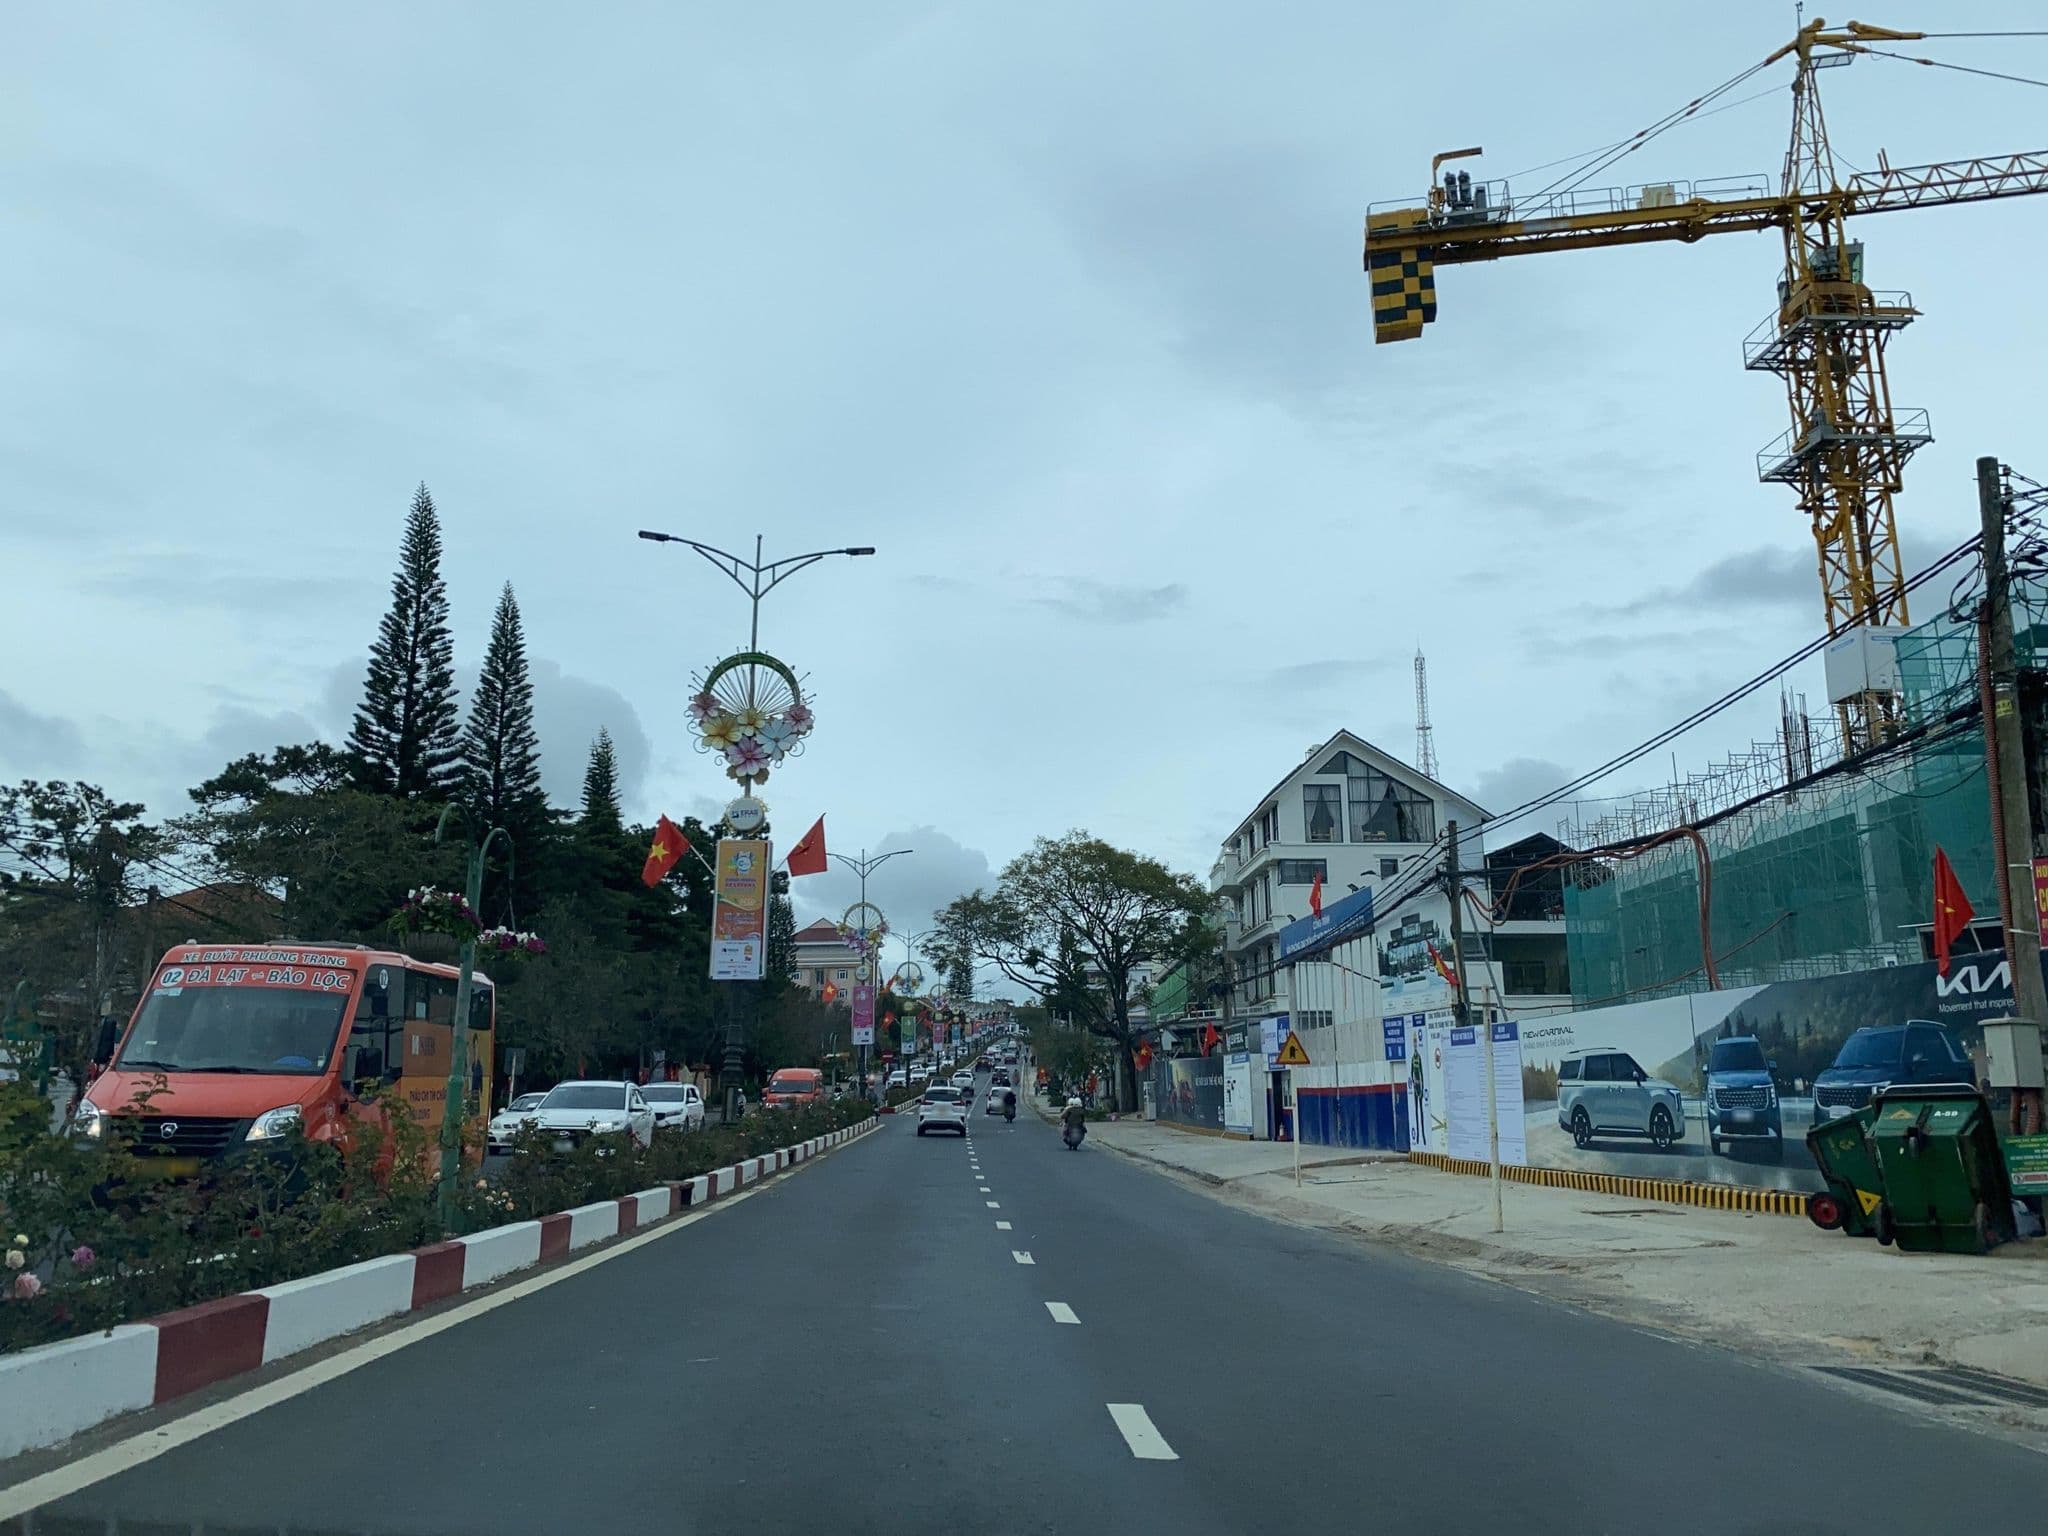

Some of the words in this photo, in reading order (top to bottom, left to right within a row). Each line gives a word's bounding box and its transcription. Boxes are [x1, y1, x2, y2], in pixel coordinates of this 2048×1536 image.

[183, 952, 200, 963] XE
[240, 949, 298, 964] PHƯƠNG
[302, 953, 347, 967] TRANG
[161, 970, 182, 984] 02
[186, 966, 211, 984] ĐÀ
[216, 968, 249, 986] LẠT
[266, 965, 306, 985] BẢO
[311, 970, 351, 991] LỘC
[1936, 961, 2012, 997] KIA
[1938, 1002, 1973, 1013] Movement
[1974, 1000, 1987, 1009] that
[1988, 998, 2015, 1009] inspires
